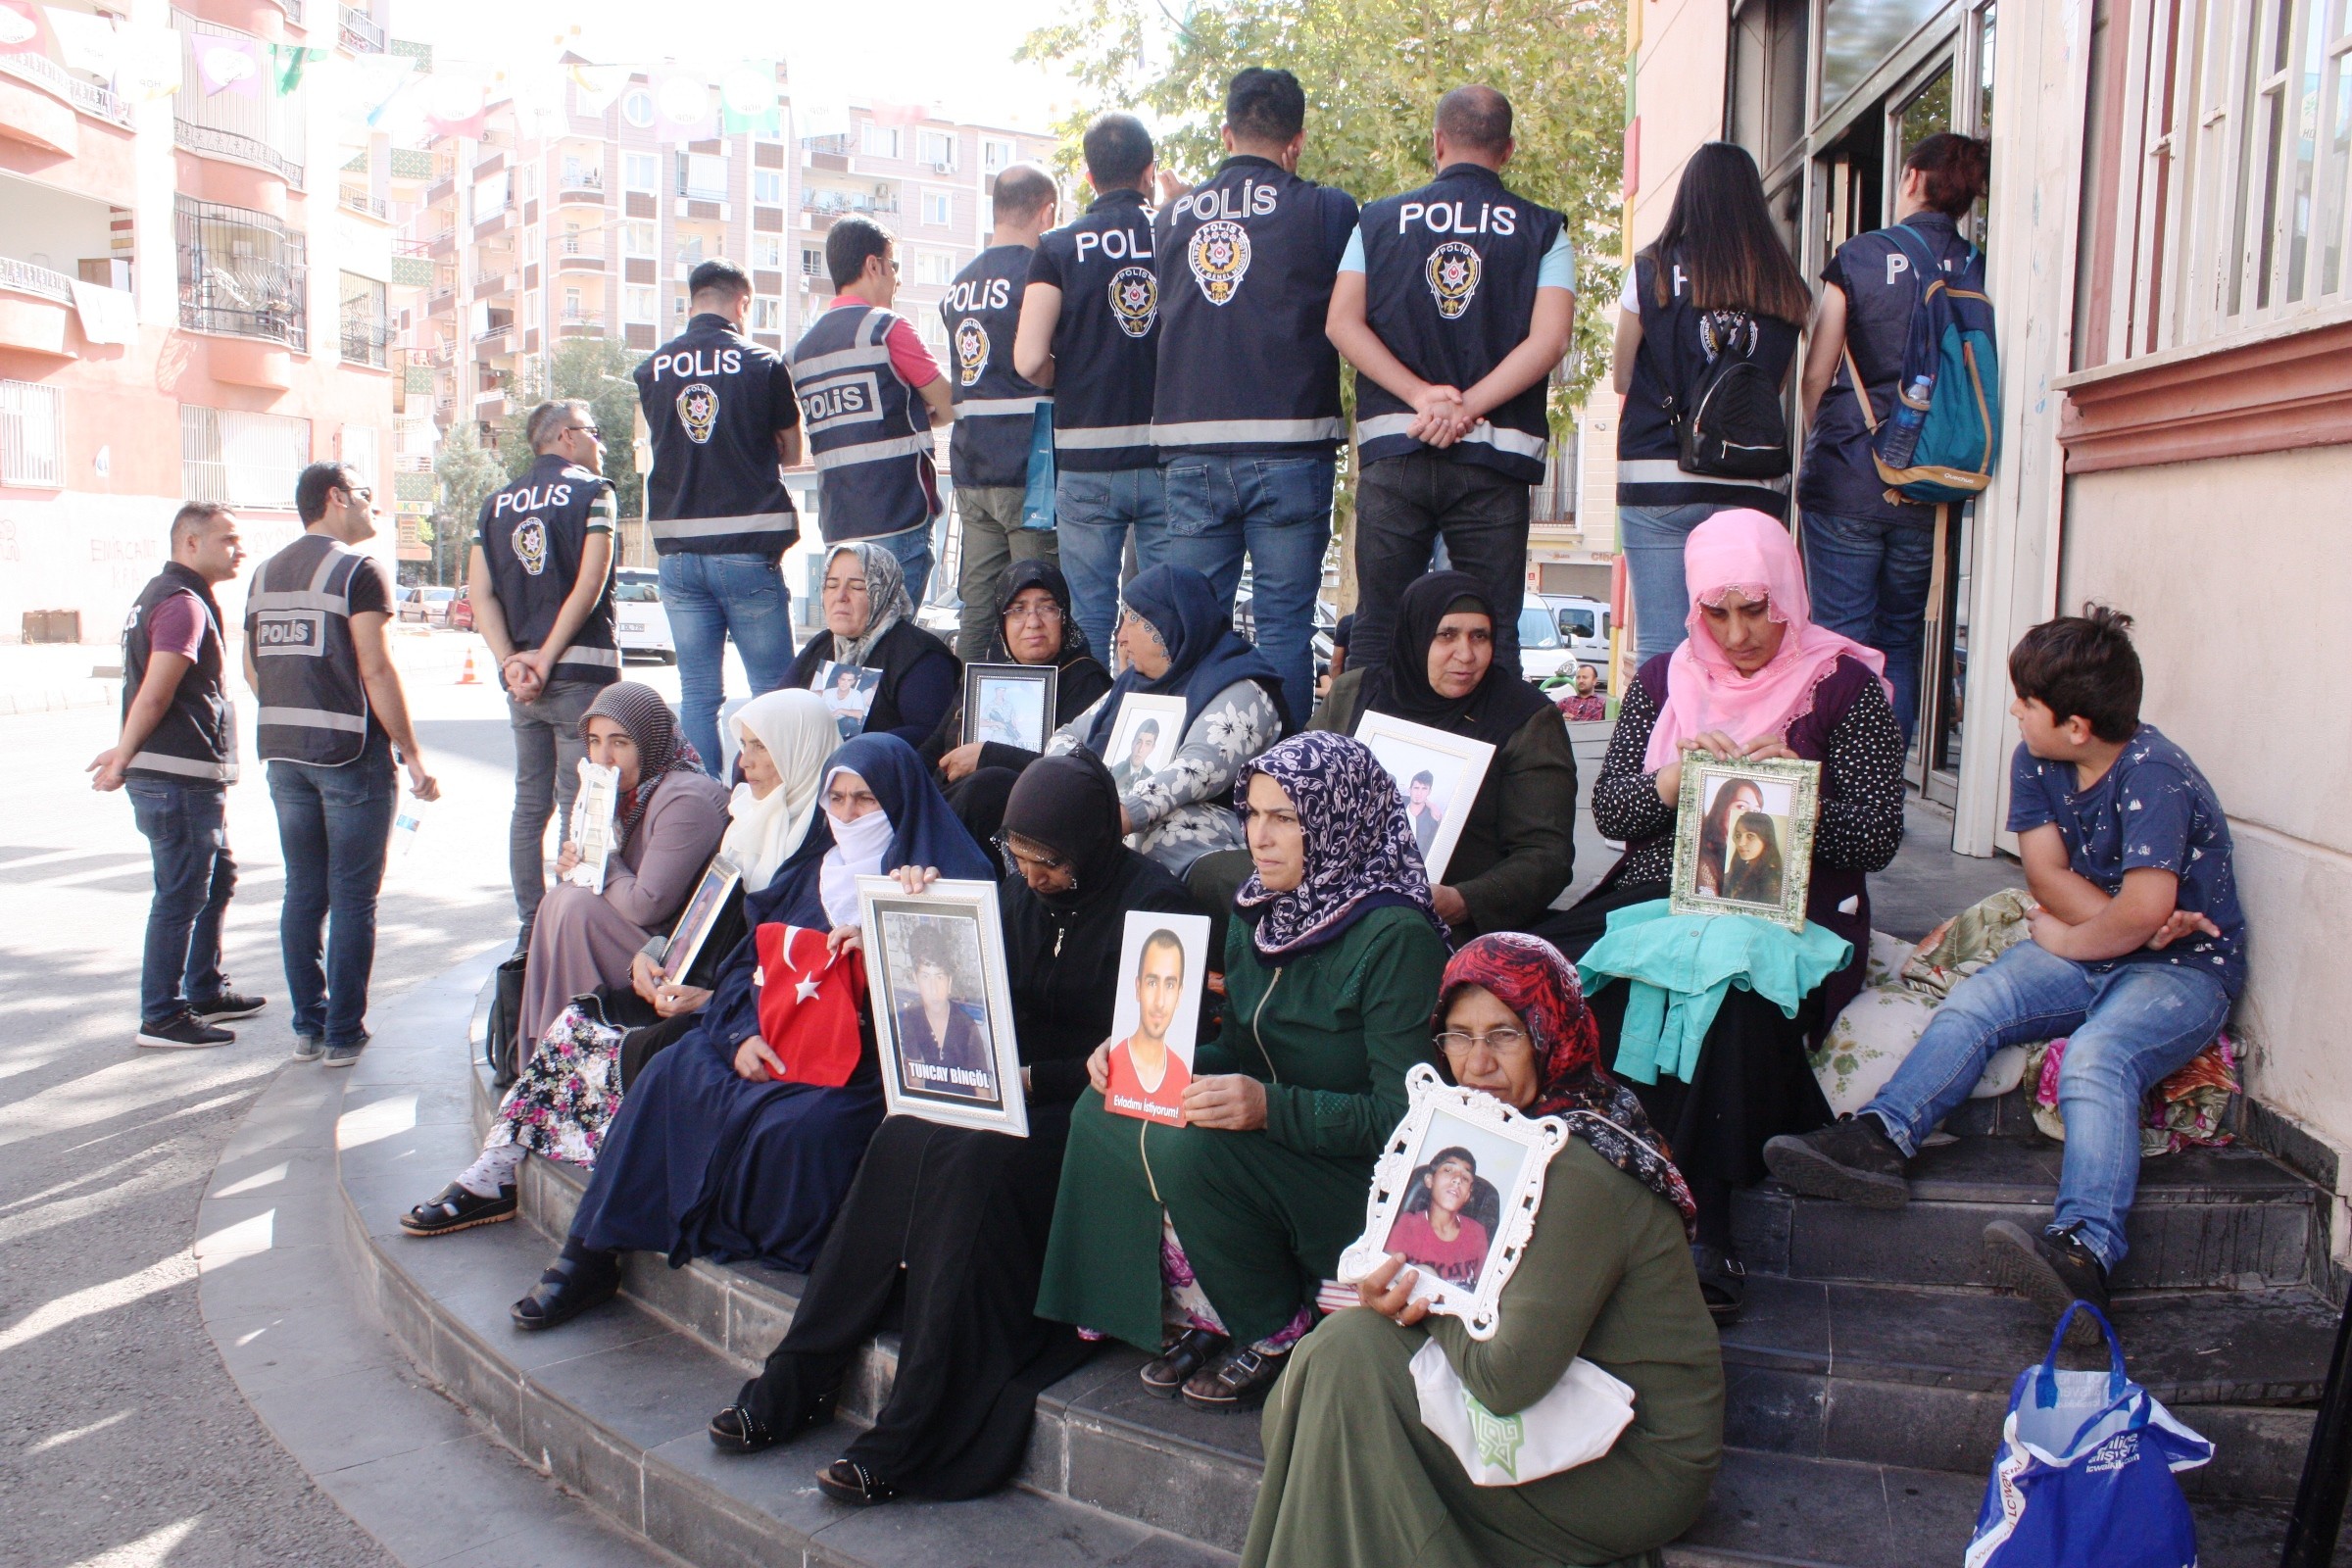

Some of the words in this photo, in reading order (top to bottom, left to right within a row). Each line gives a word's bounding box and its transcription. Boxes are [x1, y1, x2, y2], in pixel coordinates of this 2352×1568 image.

[1171, 179, 1278, 226] POLİS
[1399, 201, 1517, 236] POLİS
[1075, 227, 1156, 263] POLİ
[944, 278, 1011, 317] POLİS
[654, 349, 742, 382] POLİS
[801, 386, 864, 422] POLİS
[495, 483, 572, 518] POLİS
[261, 619, 309, 644] POLİS
[908, 1061, 949, 1083] TUNCAY
[950, 1066, 990, 1089] BİNGÖL
